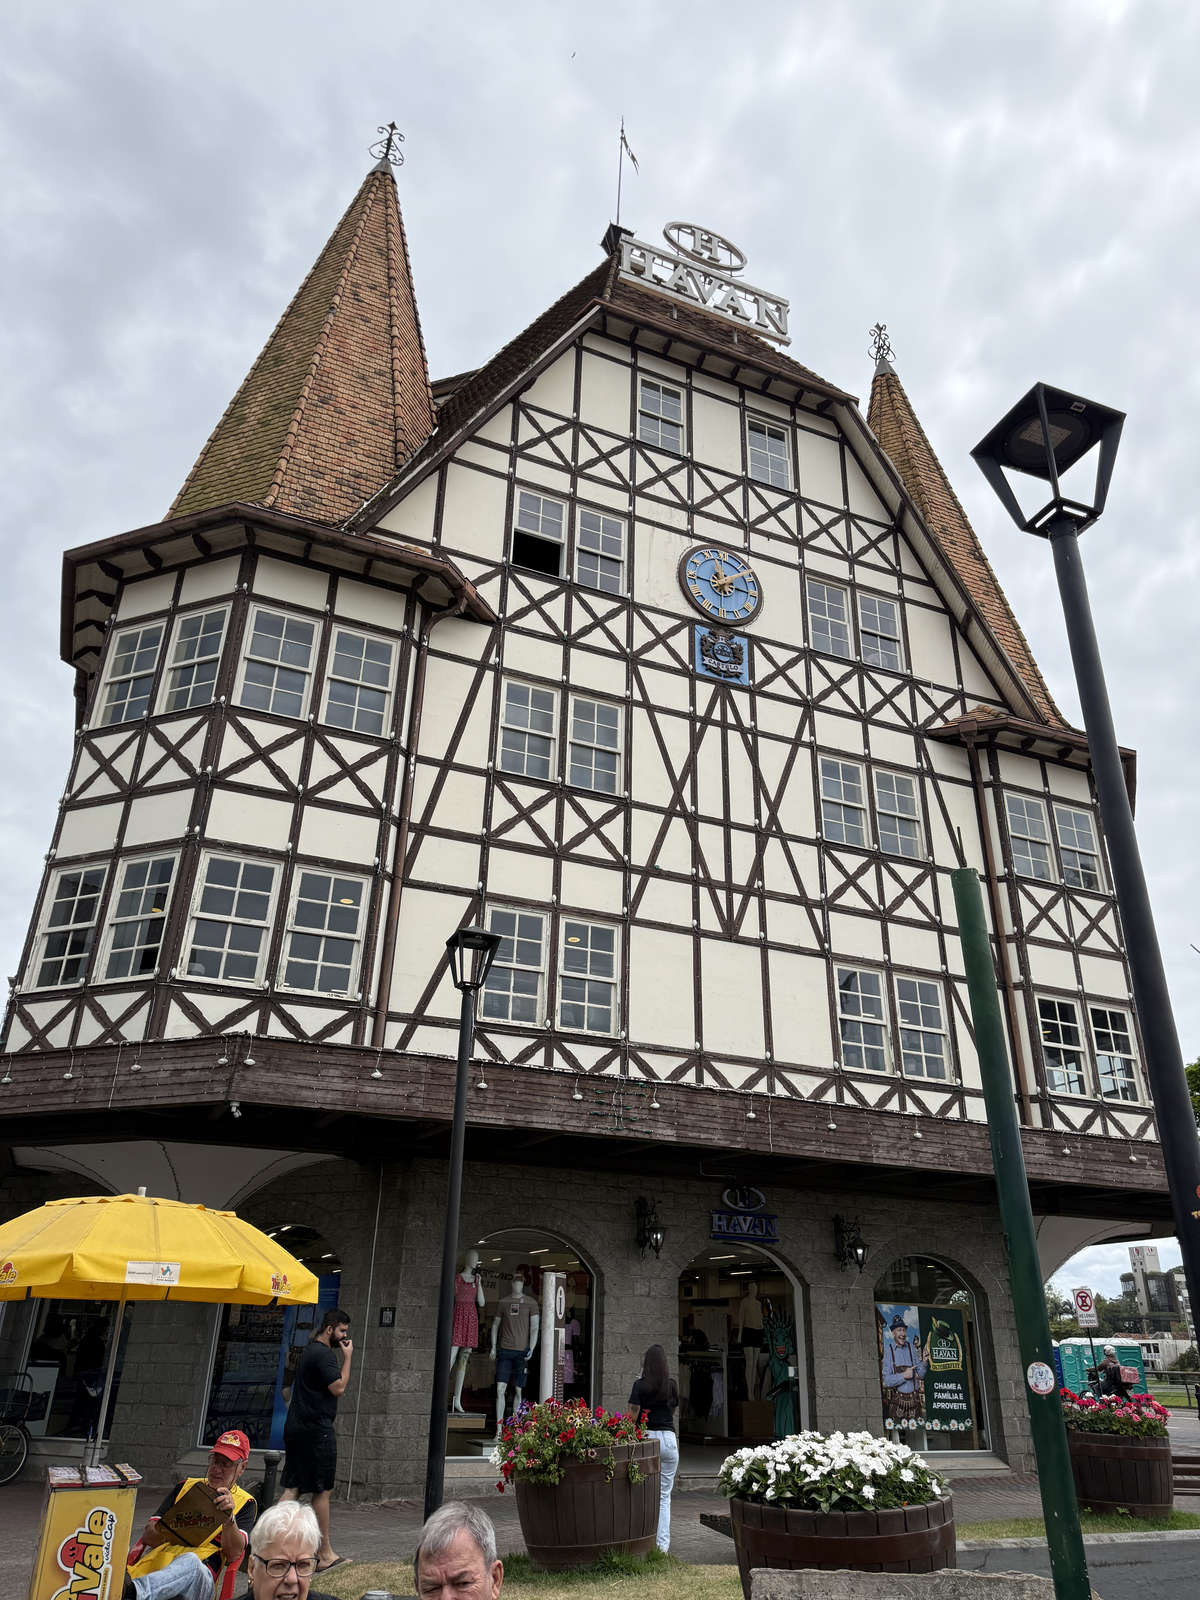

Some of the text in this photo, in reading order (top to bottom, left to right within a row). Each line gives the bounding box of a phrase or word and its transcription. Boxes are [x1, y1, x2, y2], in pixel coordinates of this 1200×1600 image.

[692, 228, 721, 262] H
[621, 241, 790, 335] HAVAN
[712, 1214, 777, 1238] HAVAN
[933, 1349, 957, 1358] HAVAN
[934, 1382, 956, 1390] CHAME
[934, 1391, 958, 1400] FAMÍLIA
[933, 1402, 967, 1410] APROVEITE
[103, 1514, 116, 1541] Cap
